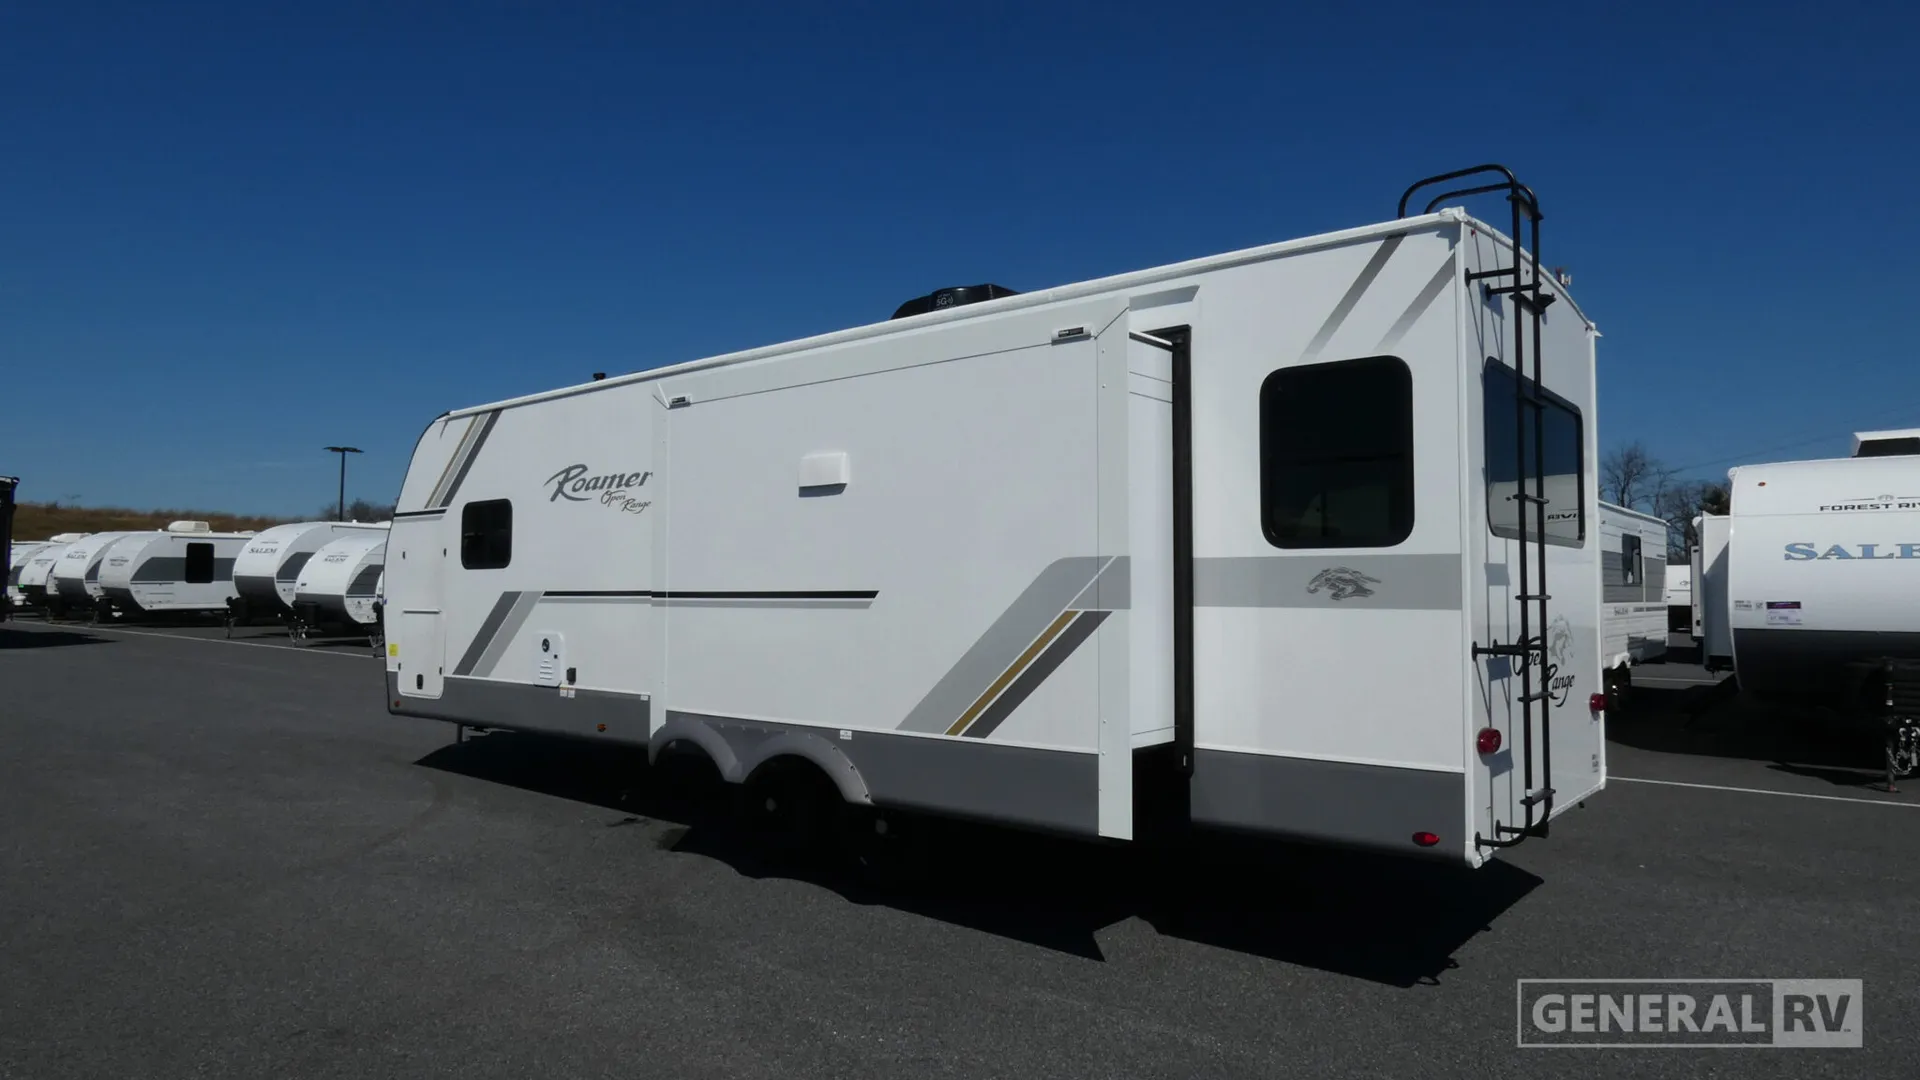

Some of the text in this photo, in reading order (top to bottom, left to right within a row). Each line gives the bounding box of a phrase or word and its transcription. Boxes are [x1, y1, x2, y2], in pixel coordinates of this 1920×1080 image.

[543, 463, 653, 502] Roamer
[600, 489, 627, 507] Open
[620, 498, 652, 514] Range
[1819, 501, 1920, 512] FOREST RI
